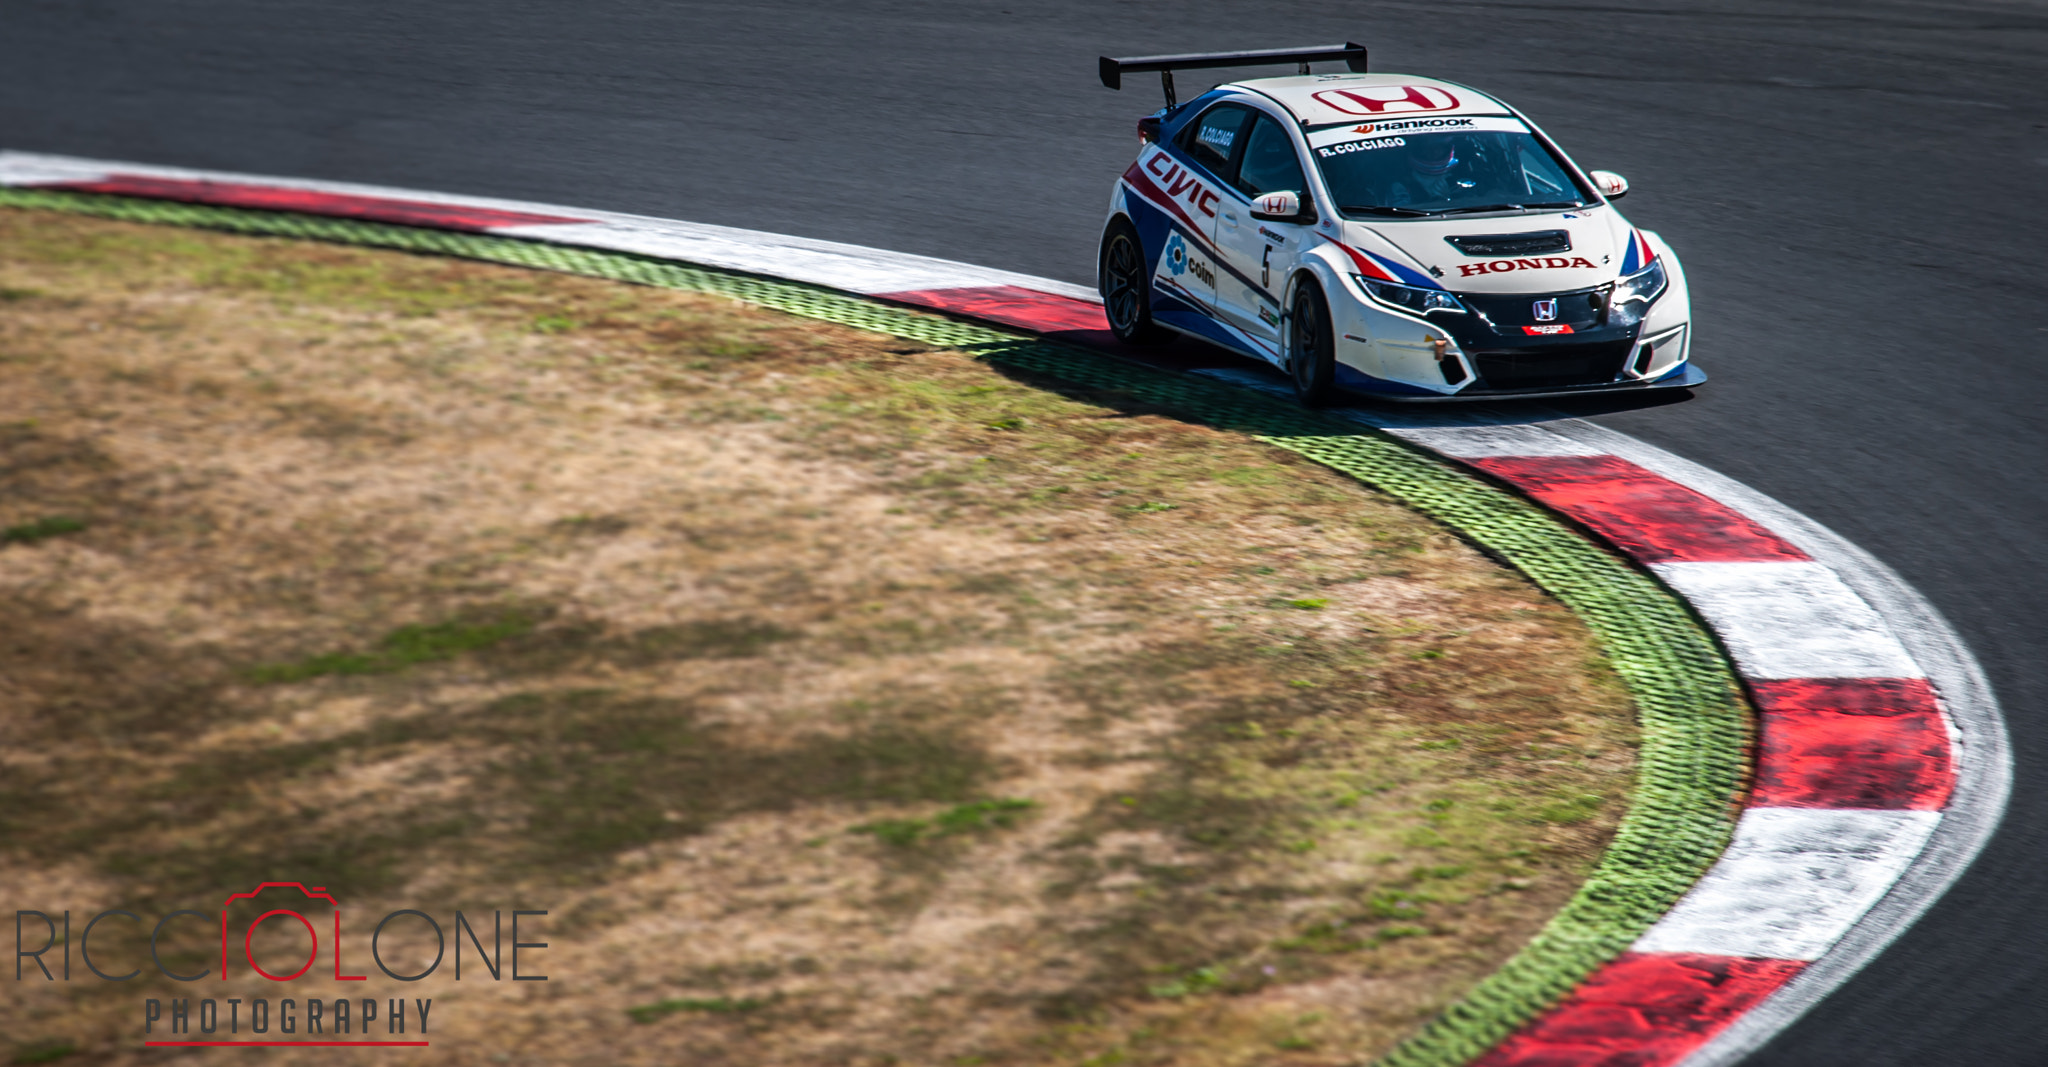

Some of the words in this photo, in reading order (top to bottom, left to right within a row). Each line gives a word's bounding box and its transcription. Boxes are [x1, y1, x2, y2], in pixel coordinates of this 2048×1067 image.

[1146, 151, 1220, 218] CIVIC
[1188, 257, 1215, 290] coim
[1261, 243, 1273, 289] 5
[1456, 256, 1598, 277] HONDA
